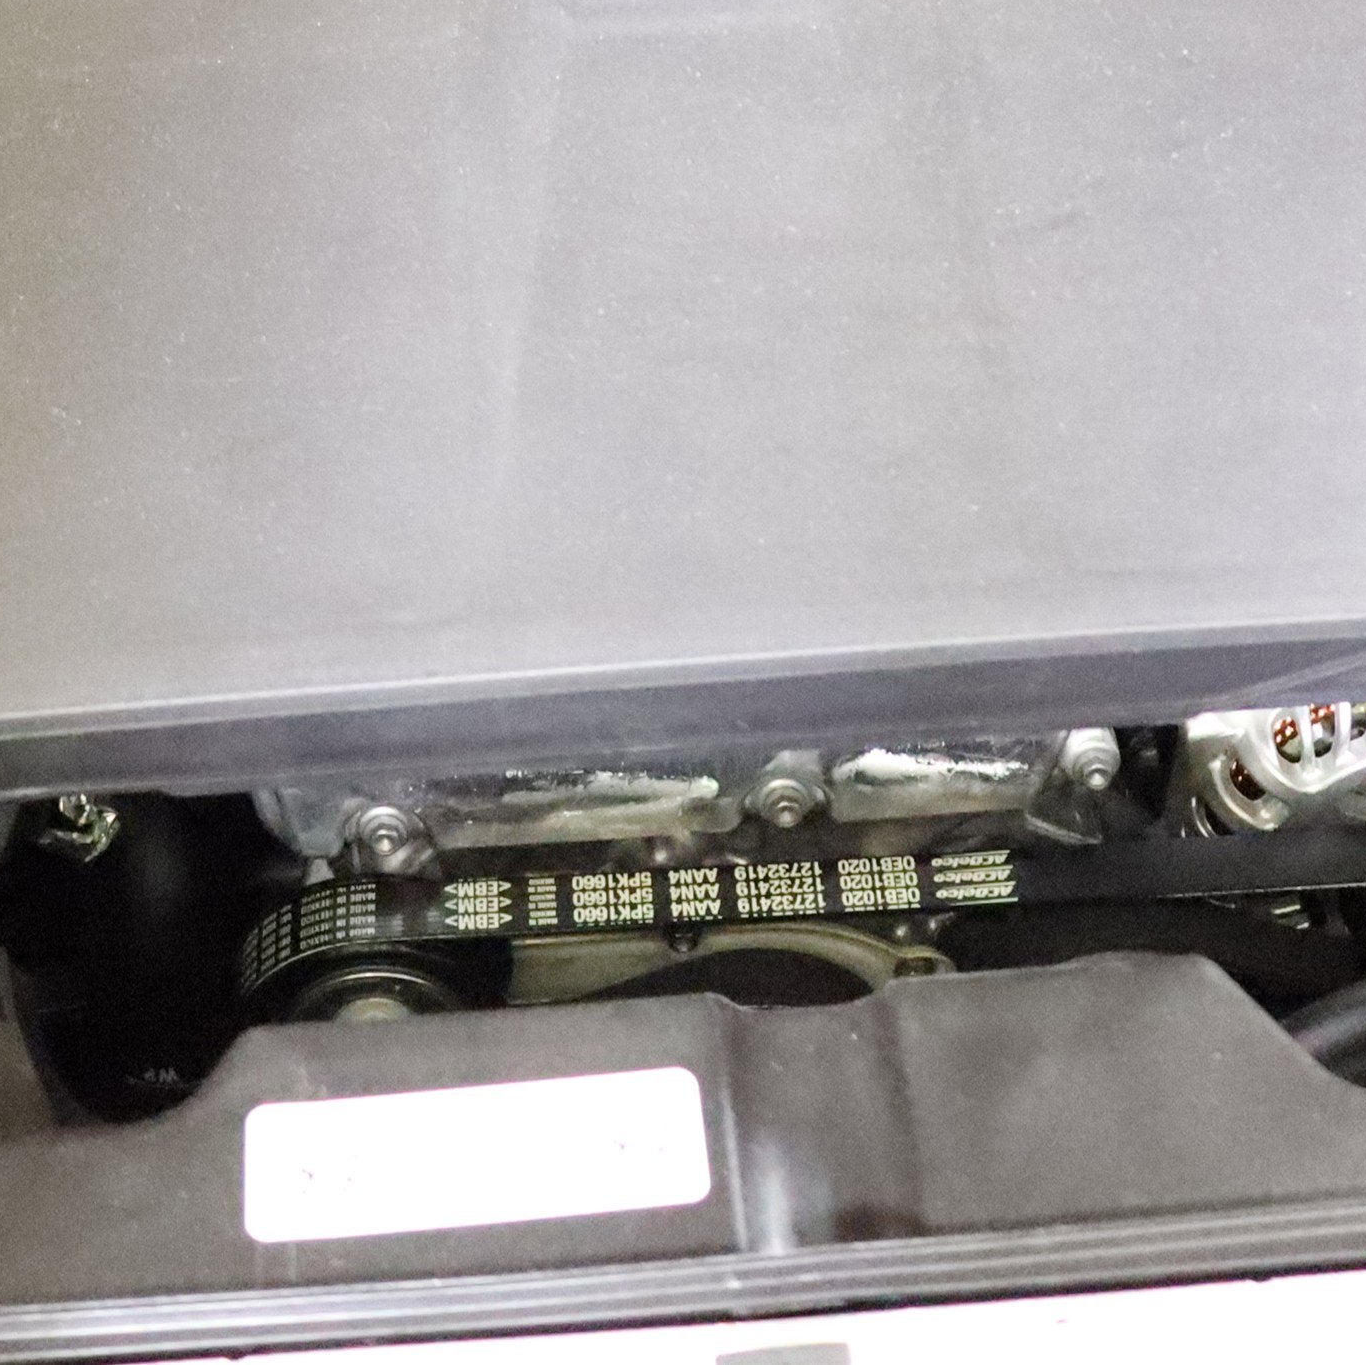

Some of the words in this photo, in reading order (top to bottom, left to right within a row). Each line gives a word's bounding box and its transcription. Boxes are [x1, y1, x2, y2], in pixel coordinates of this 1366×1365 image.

[931, 852, 1009, 868] ACDelco
[668, 868, 718, 884] AAN4
[734, 861, 823, 881] 12732419
[933, 868, 1012, 883] ACDelco
[572, 872, 652, 890] 5PK1660
[735, 877, 825, 896] 12732419
[573, 888, 653, 906] 5PK1660
[669, 883, 719, 901] AAN4
[936, 884, 1015, 899] ACDelco
[670, 899, 721, 917] AAN4
[737, 893, 826, 913] 12732419
[573, 904, 654, 923] 5PK1660
